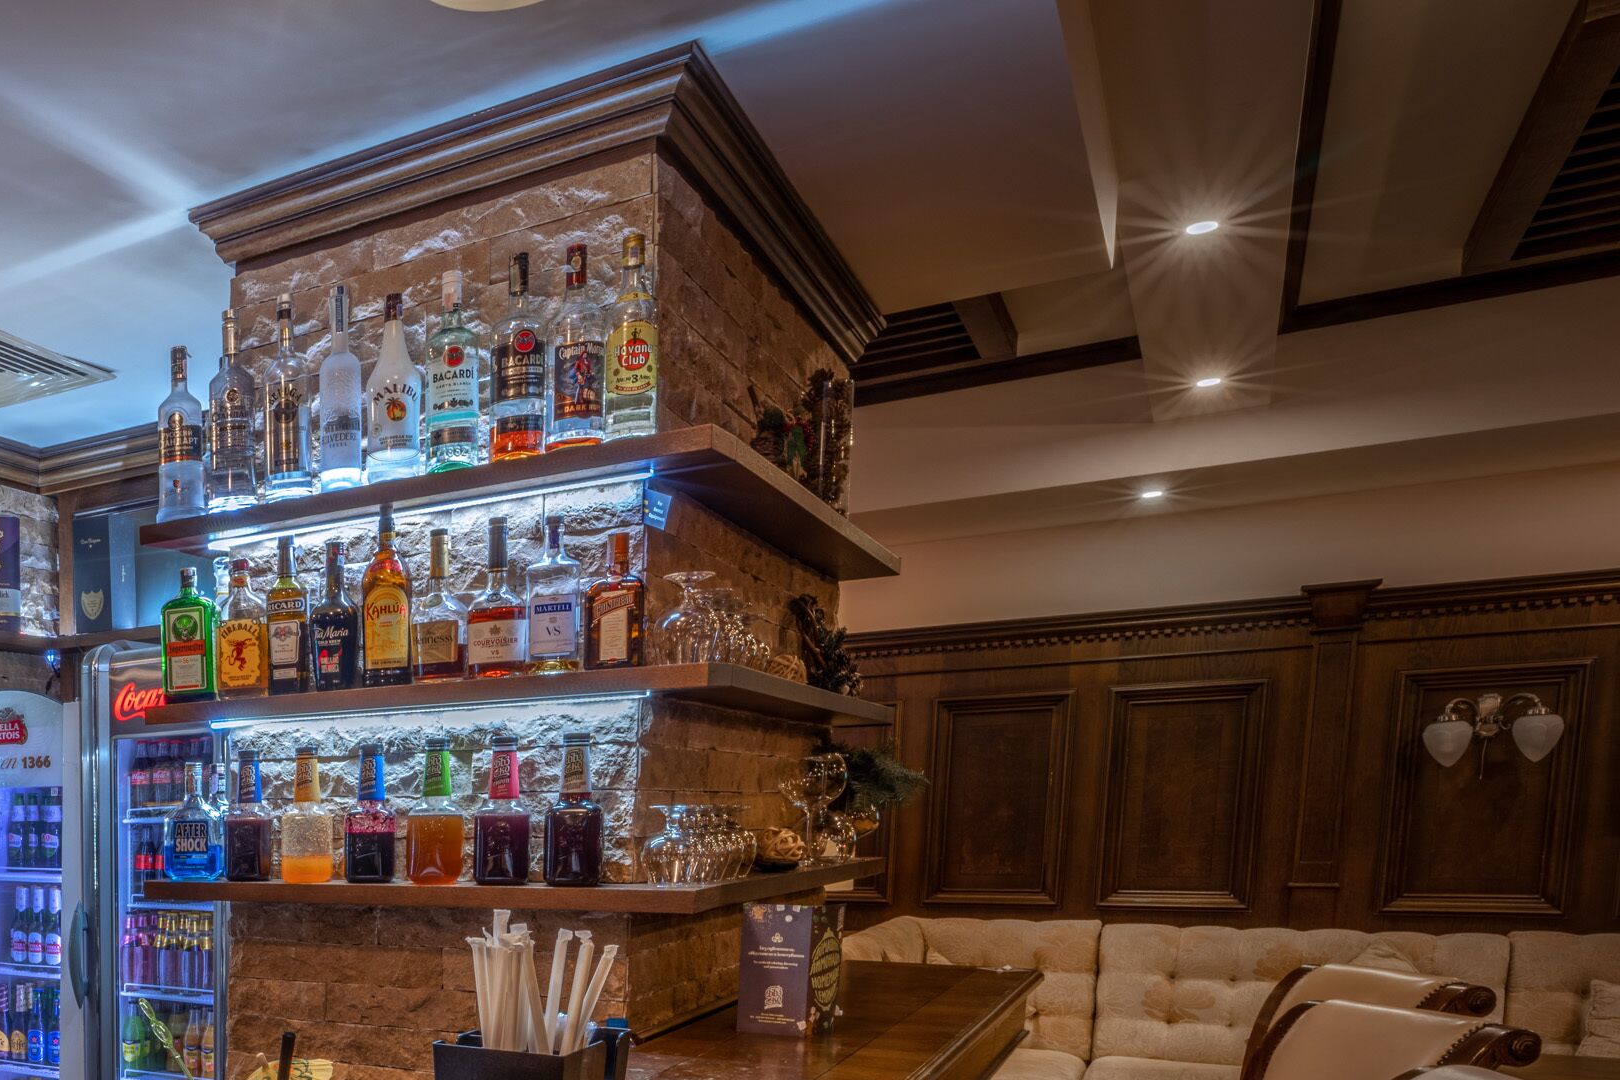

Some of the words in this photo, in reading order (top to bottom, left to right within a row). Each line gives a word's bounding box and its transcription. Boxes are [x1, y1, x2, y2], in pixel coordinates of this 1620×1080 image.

[559, 345, 585, 360] Captain
[614, 345, 652, 357] Havana
[501, 353, 544, 367] BACARDÍ
[621, 353, 645, 366] Club
[432, 367, 474, 384] BACARDÍ
[631, 374, 638, 384] 3
[373, 383, 418, 406] MALIBU
[564, 404, 587, 413] DARK
[268, 600, 301, 612] RICARD
[366, 601, 407, 620] KAHLÚA
[534, 603, 571, 613] MARTELL
[221, 622, 258, 640] FIREBALL
[324, 626, 349, 640] Maria
[545, 626, 561, 637] VS
[473, 637, 518, 648] COURVOISIER
[22, 755, 51, 769] 1366
[176, 823, 206, 838] AFTER
[175, 838, 207, 852] SHOCK
